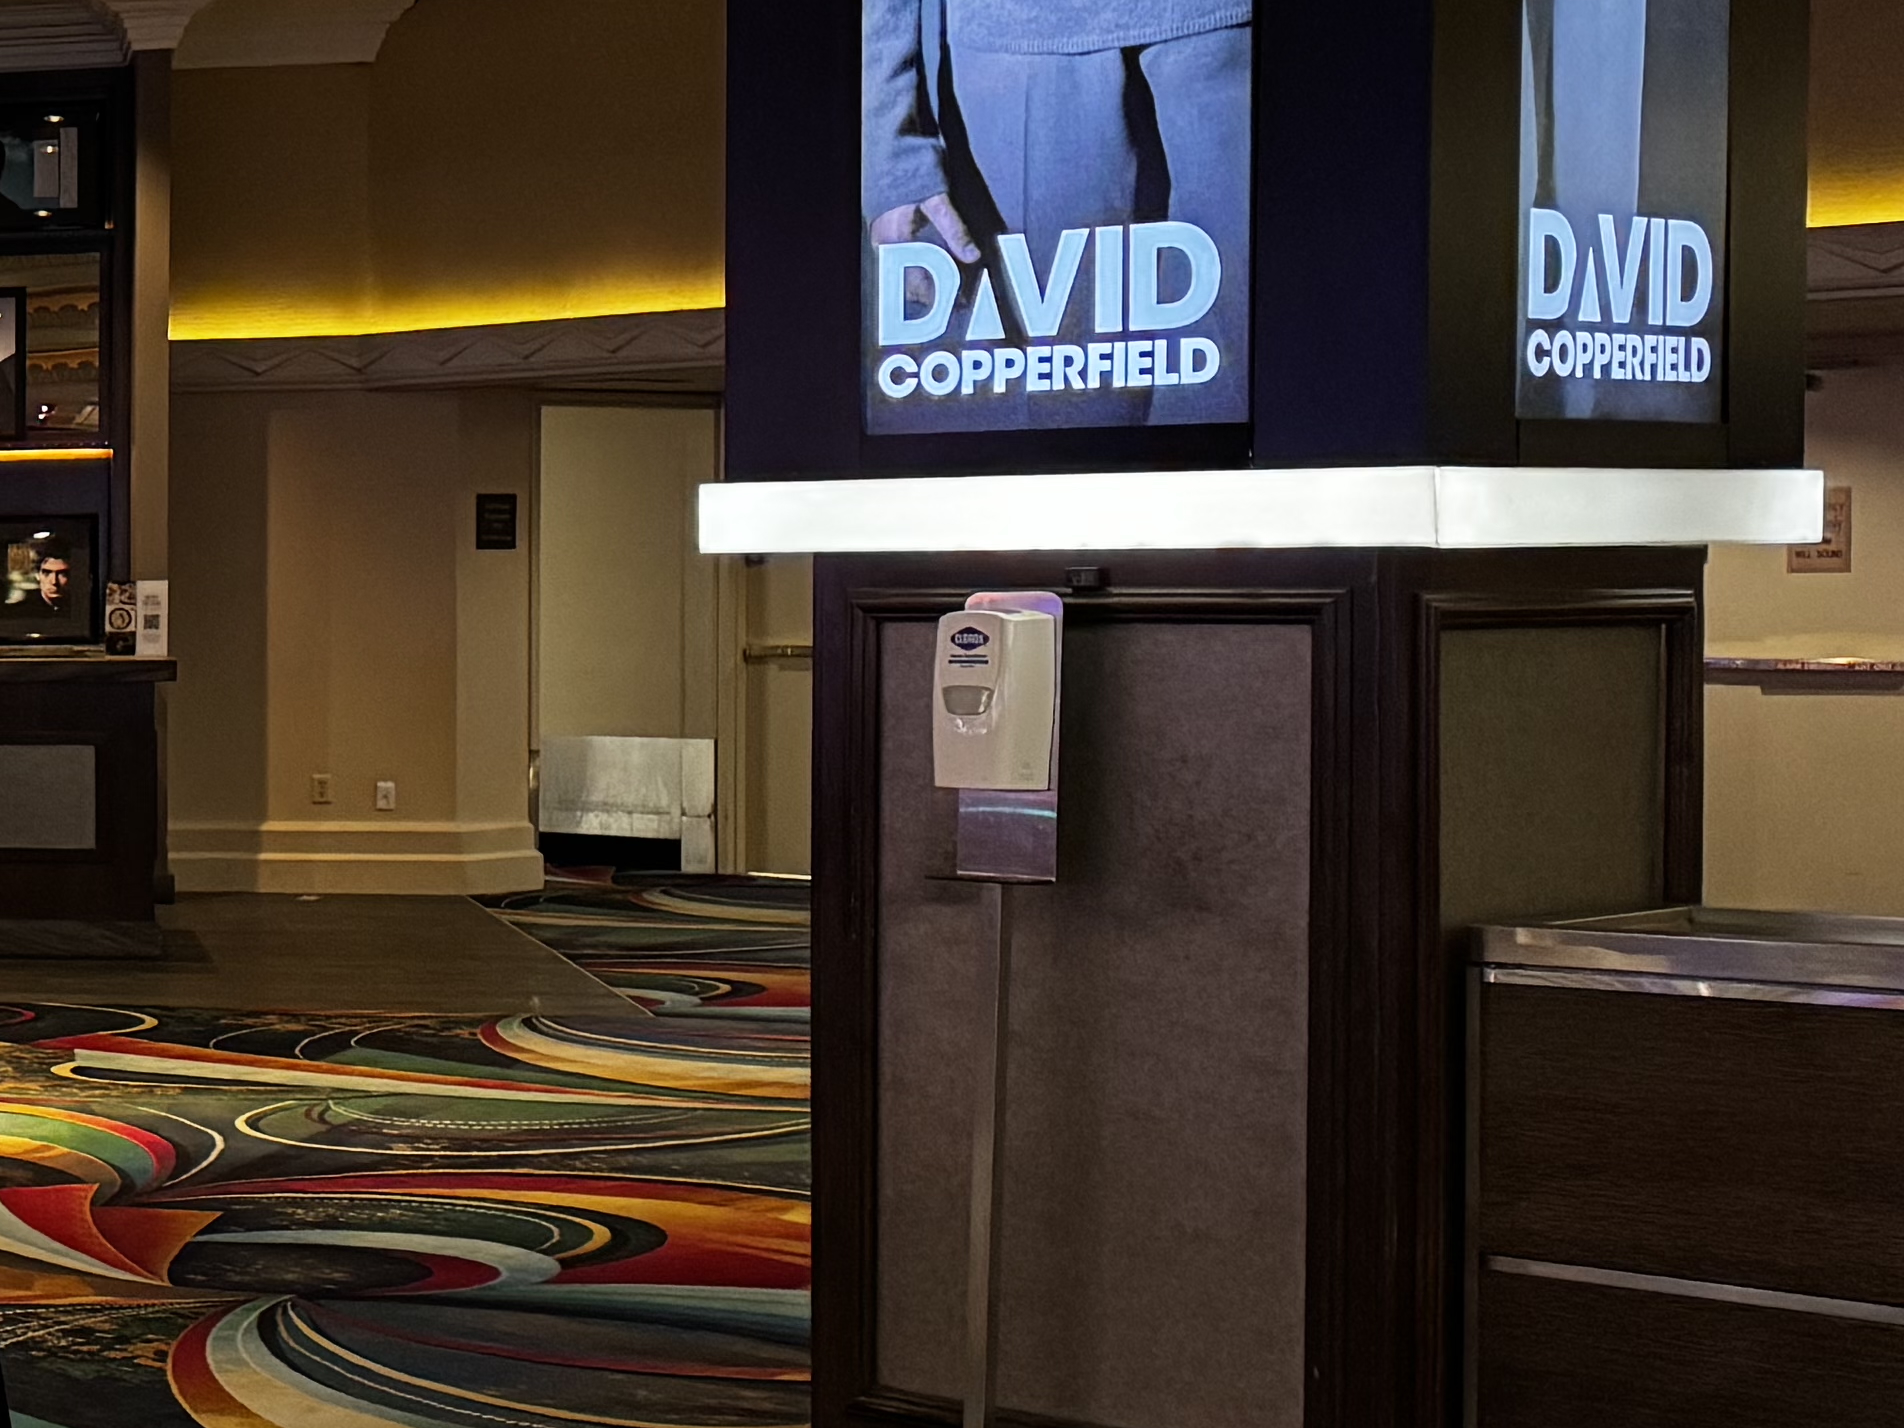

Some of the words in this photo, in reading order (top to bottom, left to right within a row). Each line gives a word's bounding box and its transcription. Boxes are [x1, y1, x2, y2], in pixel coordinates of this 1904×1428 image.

[878, 221, 1222, 347] DAVID
[1527, 207, 1713, 327] DAVID
[878, 337, 1221, 399] COPPERFIELD
[1527, 328, 1711, 383] COPPERFIELD
